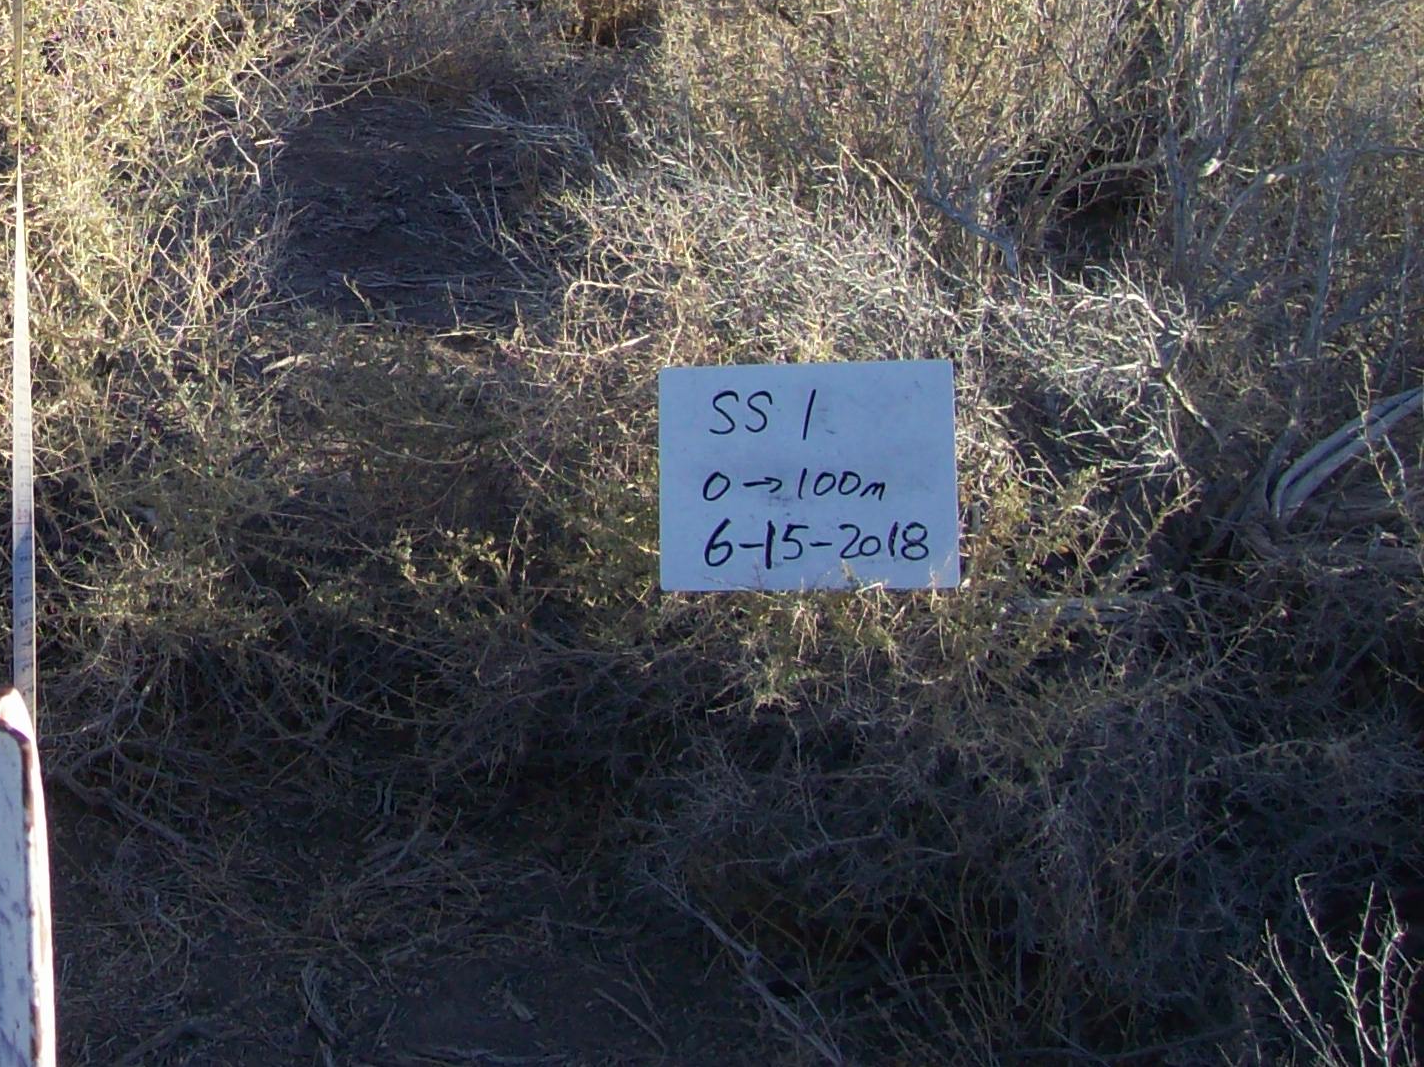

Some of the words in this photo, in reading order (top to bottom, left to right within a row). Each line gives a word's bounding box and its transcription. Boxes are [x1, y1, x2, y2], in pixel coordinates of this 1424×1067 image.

[709, 390, 773, 435] SS
[802, 388, 817, 441] 1
[797, 467, 886, 502] 100m
[704, 518, 930, 570] 6-15-2018
